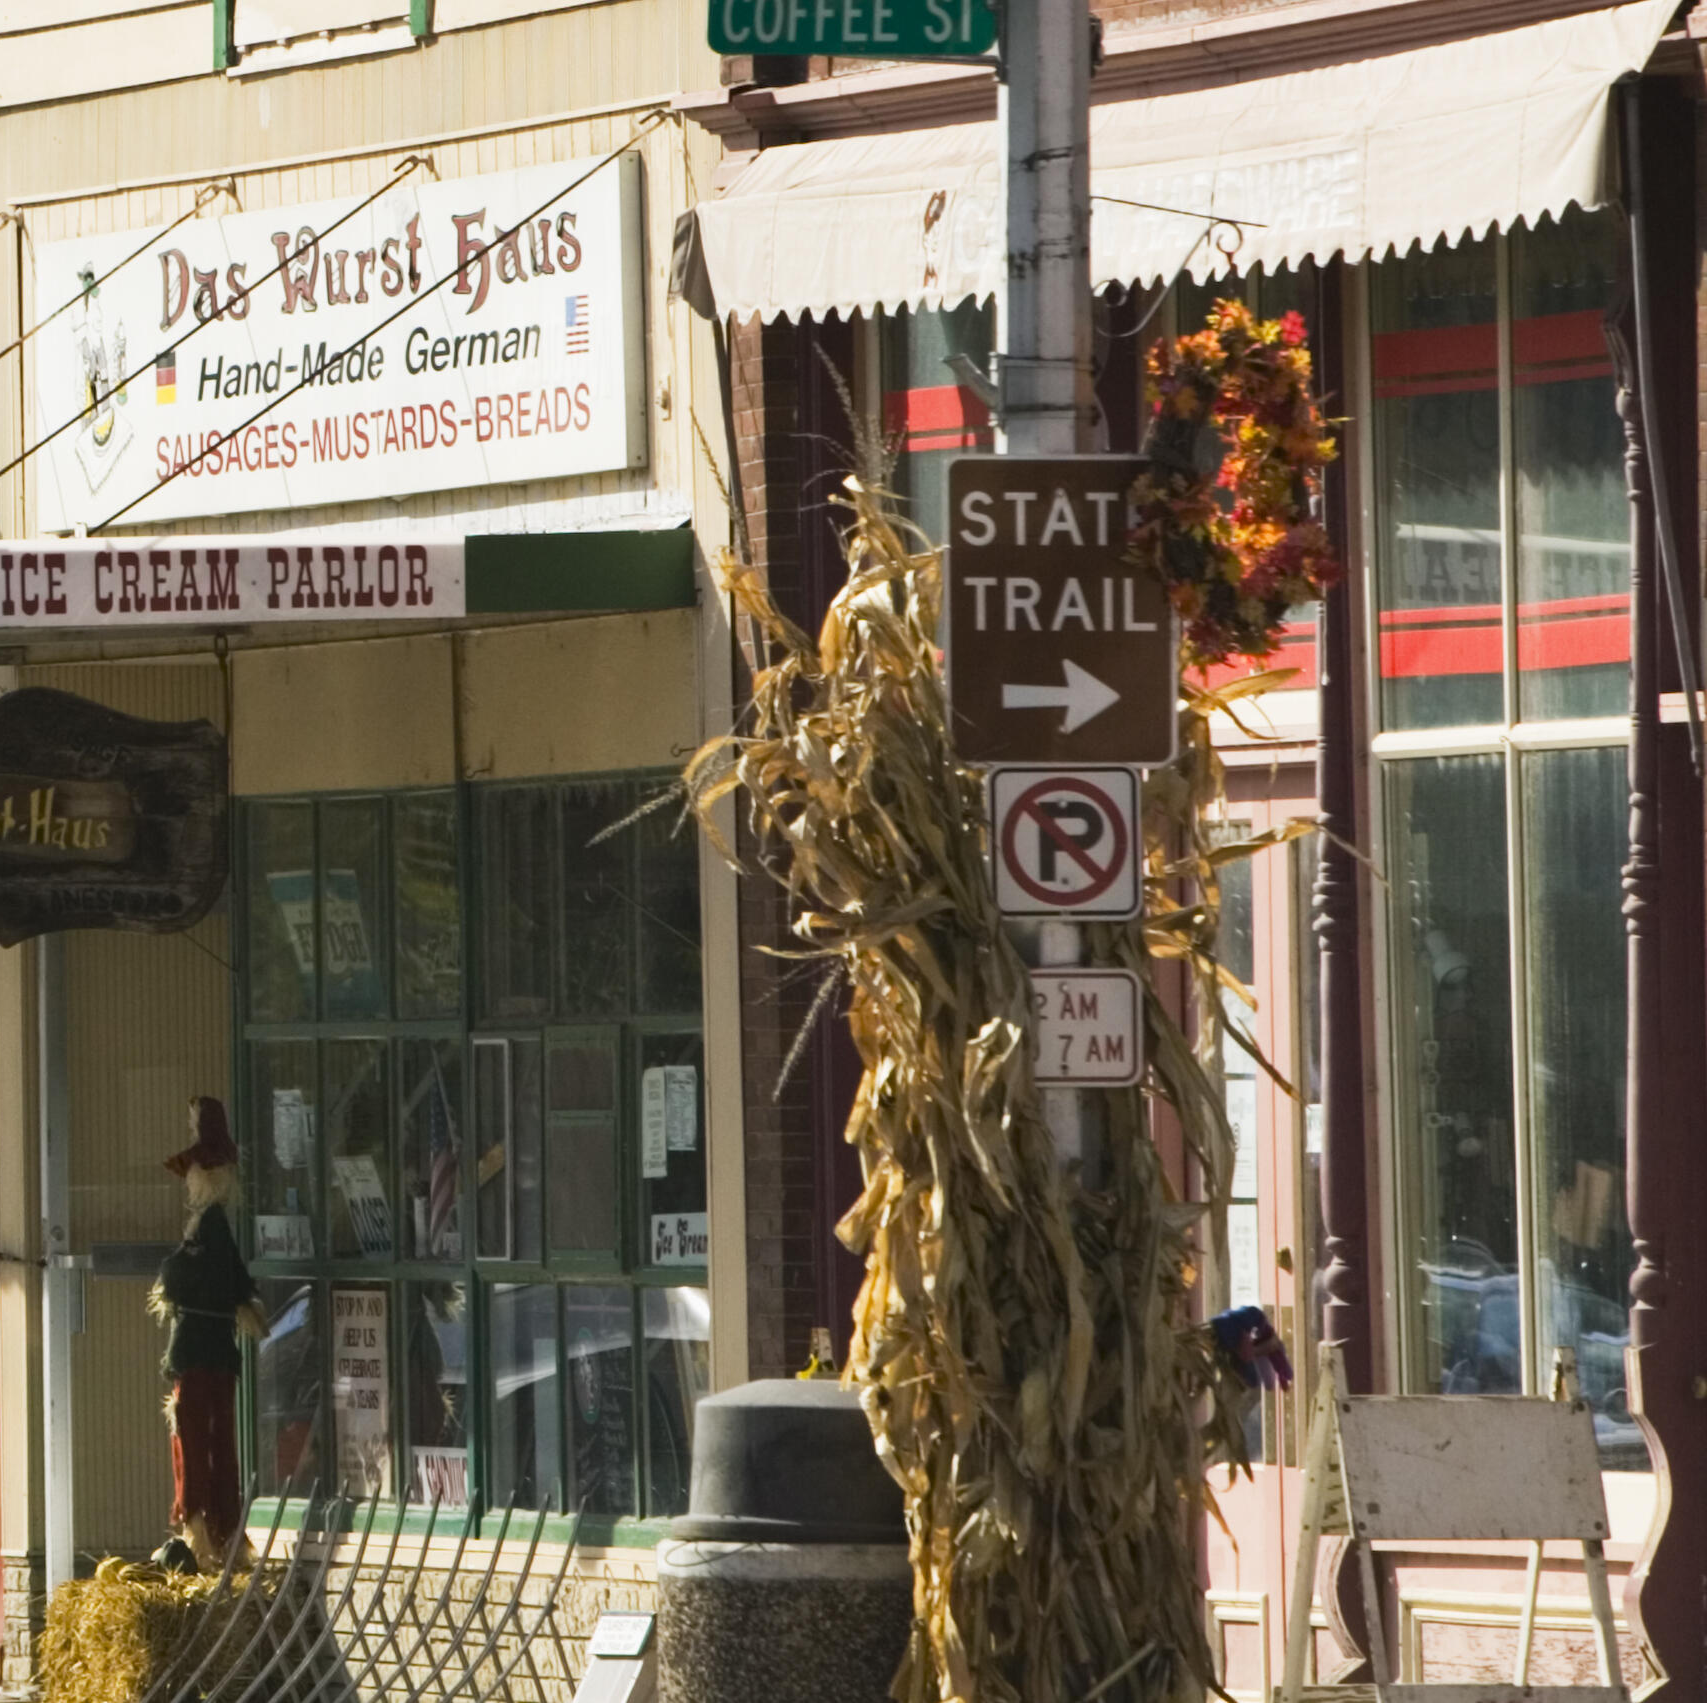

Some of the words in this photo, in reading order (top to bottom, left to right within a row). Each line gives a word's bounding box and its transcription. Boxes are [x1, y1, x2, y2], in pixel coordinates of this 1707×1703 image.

[158, 247, 251, 333] Das
[271, 211, 422, 315] Wurst
[451, 206, 583, 315] Haus
[198, 338, 384, 402] Hand-Made
[406, 324, 542, 376] German
[156, 381, 591, 484] SAUSAGES-MUSTARDS-BREADS
[960, 488, 1137, 547] STAT
[1, 553, 67, 617] ICE
[95, 548, 241, 615] CREAM
[267, 544, 435, 609] PARLOR
[963, 576, 1159, 632] TRAIL
[1060, 992, 1099, 1020] AM
[1058, 1035, 1075, 1063] 7
[1085, 1035, 1126, 1063] AM
[656, 1220, 673, 1261] Ice
[366, 1296, 383, 1316] AND
[343, 1328, 361, 1347] HELP
[364, 1328, 377, 1347] US
[338, 1359, 382, 1378] CELEBRATE
[355, 1390, 379, 1409] YEARS
